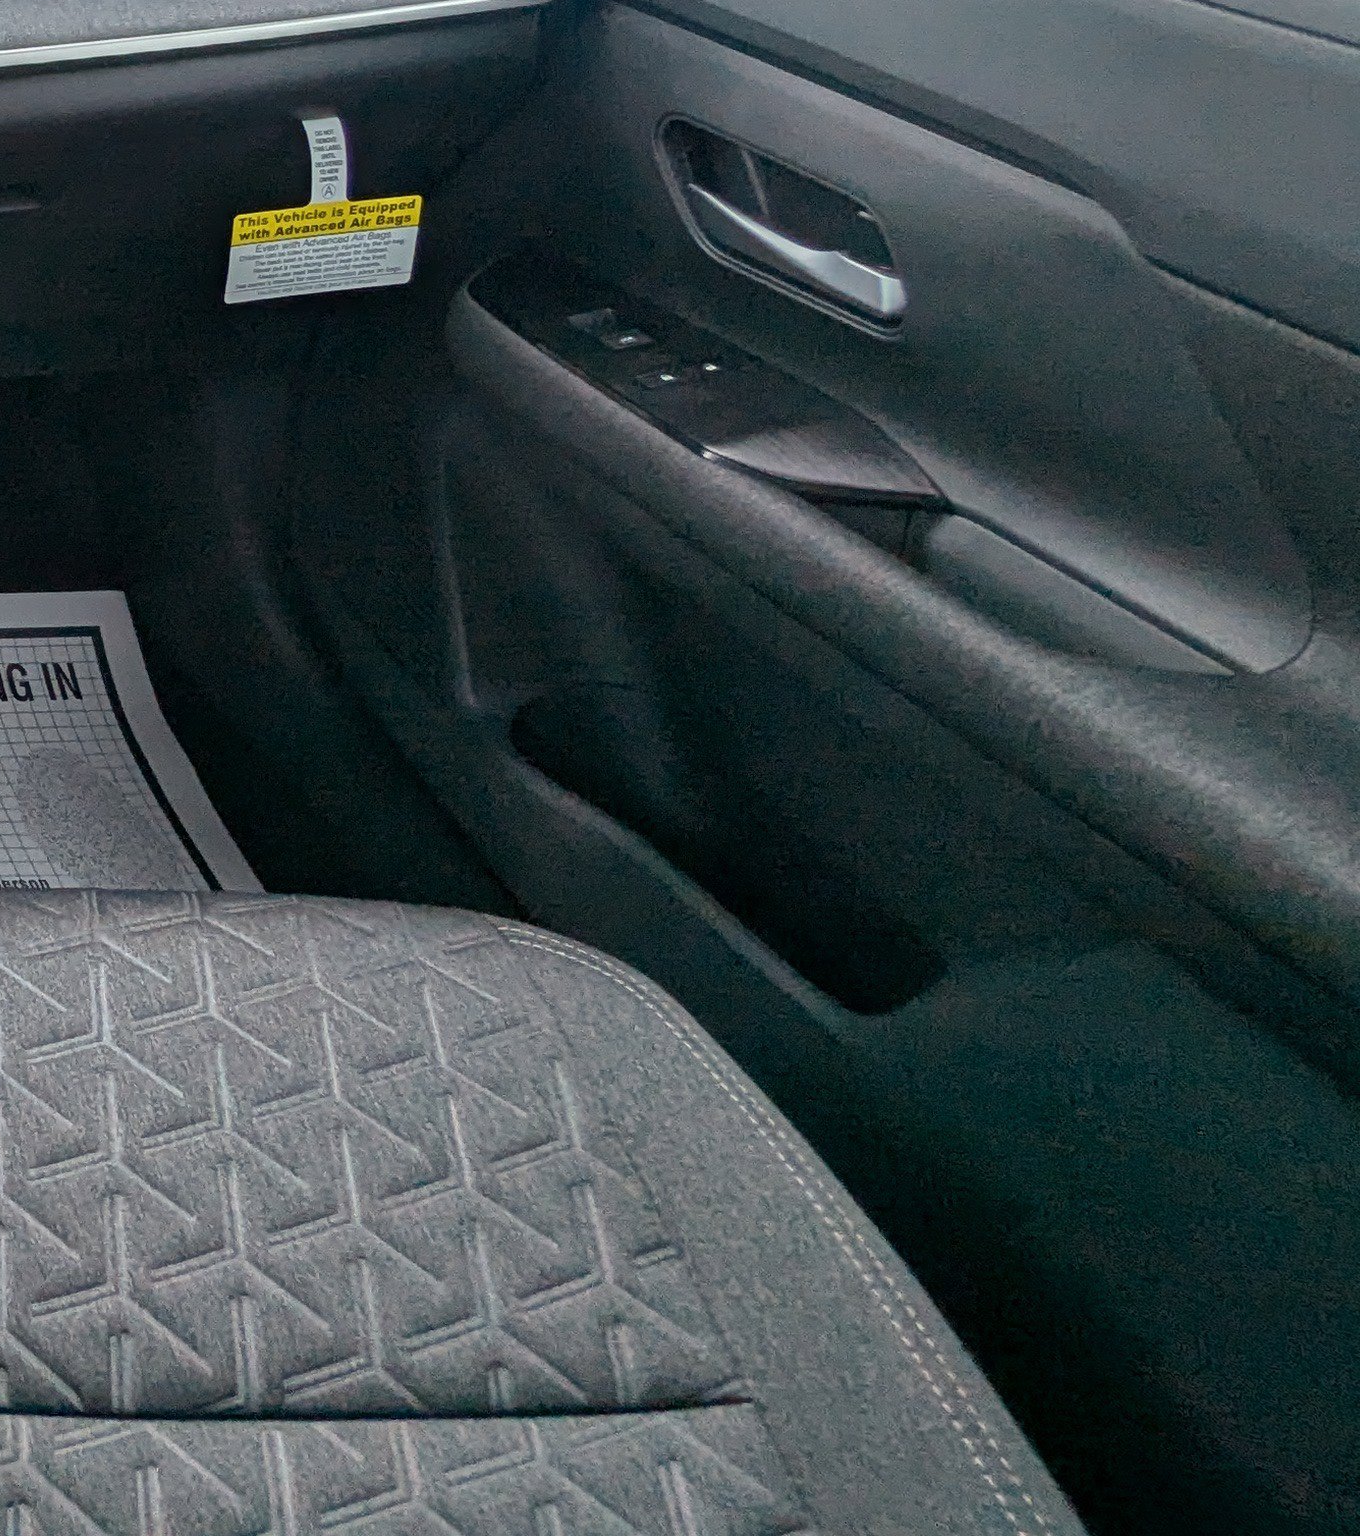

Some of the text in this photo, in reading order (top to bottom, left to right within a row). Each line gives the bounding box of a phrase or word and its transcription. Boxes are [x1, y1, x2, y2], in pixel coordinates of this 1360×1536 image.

[238, 198, 417, 228] This Vehicle is Equipped
[239, 214, 412, 241] with Advanced Air Bags
[255, 244, 279, 253] Even
[302, 235, 349, 247] Advanced
[350, 233, 367, 242] Air
[367, 231, 392, 241] Bags
[44, 662, 84, 701] IN
